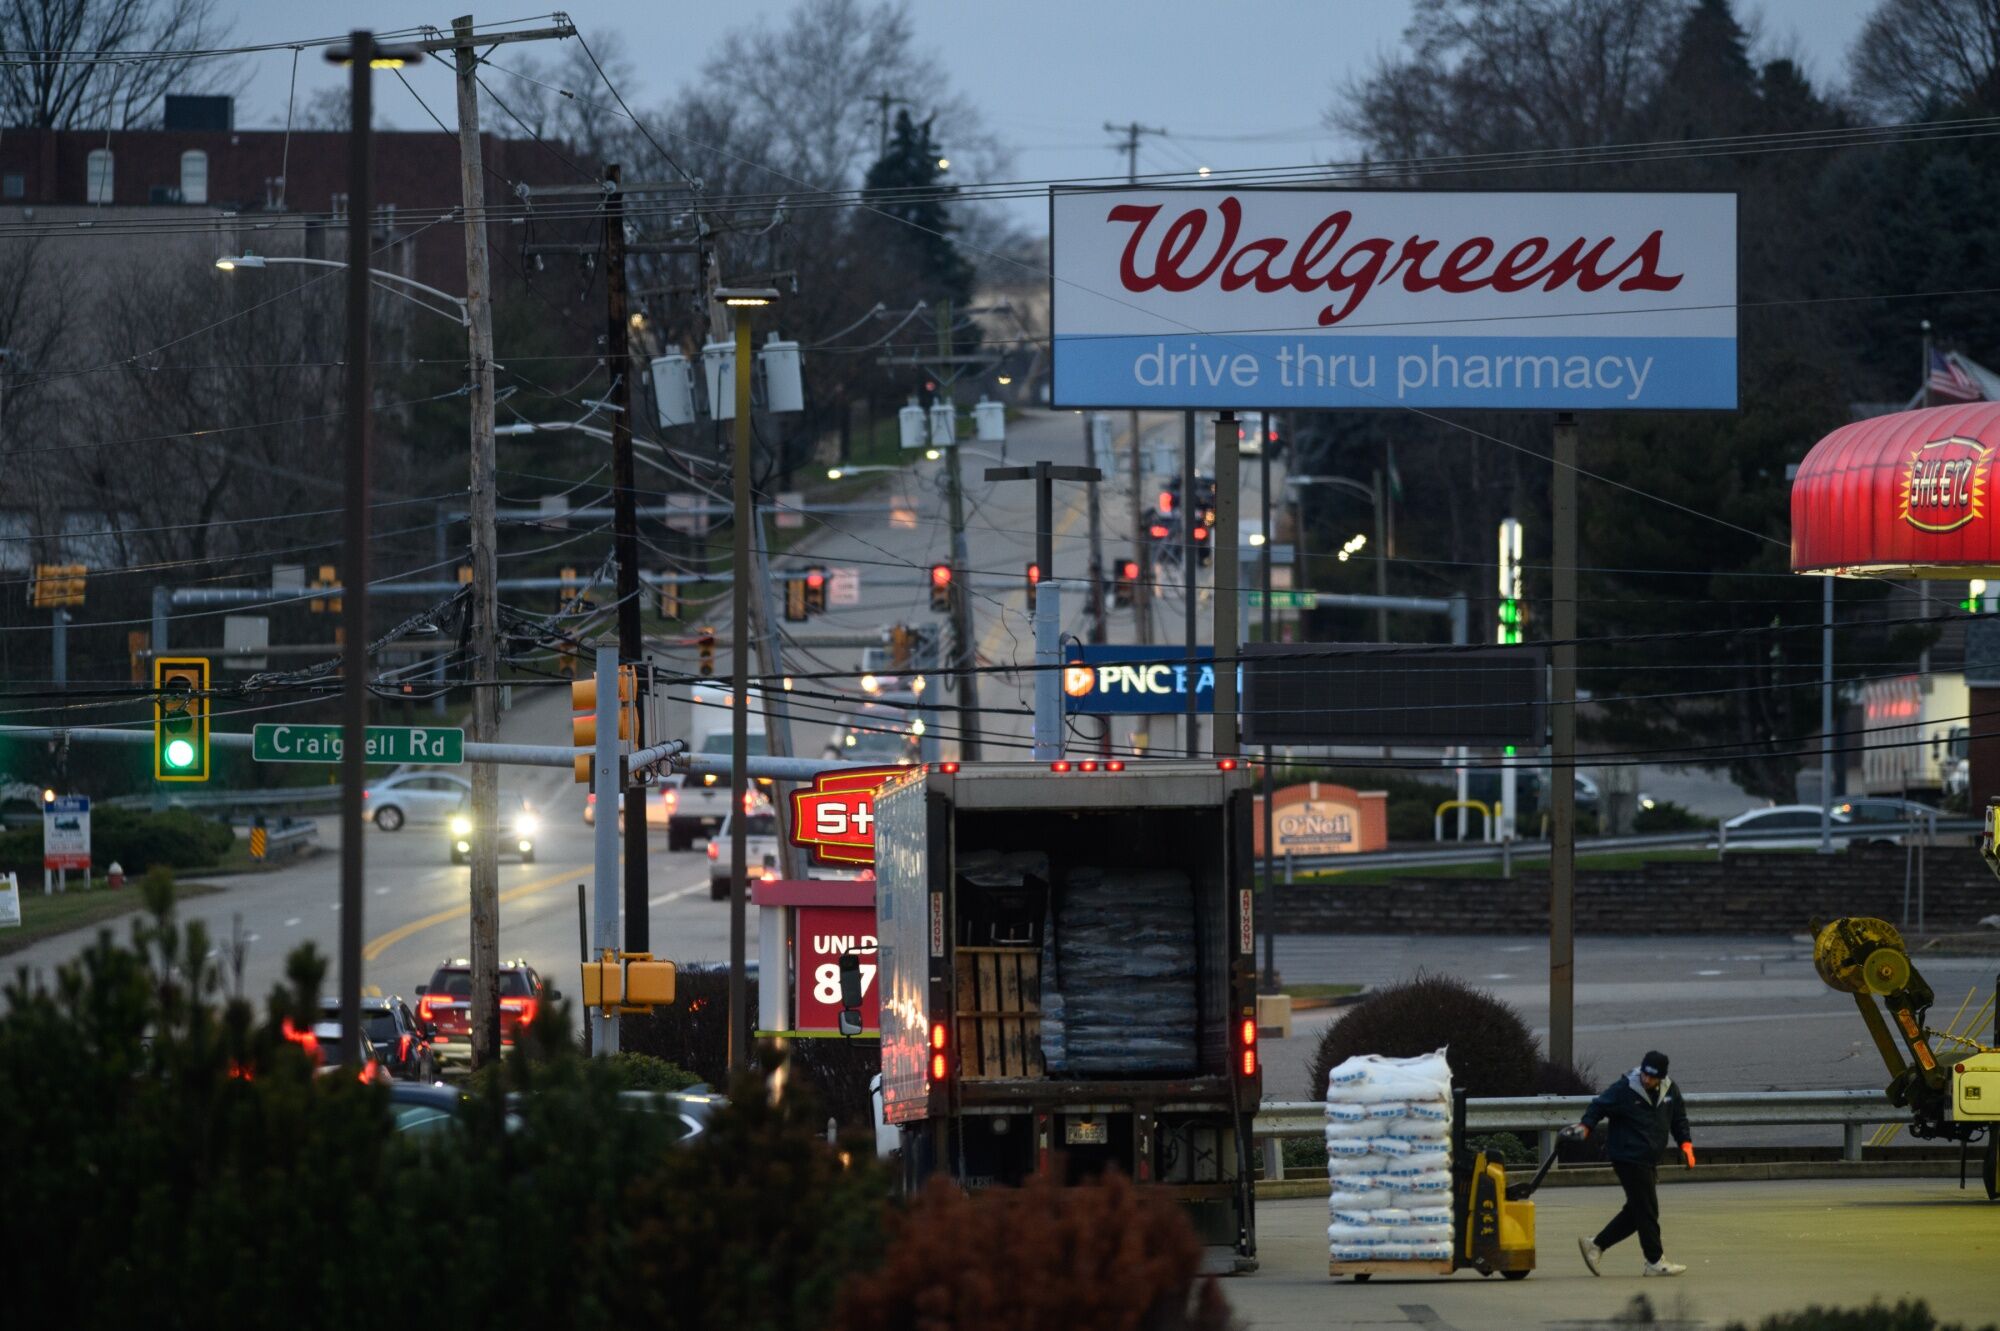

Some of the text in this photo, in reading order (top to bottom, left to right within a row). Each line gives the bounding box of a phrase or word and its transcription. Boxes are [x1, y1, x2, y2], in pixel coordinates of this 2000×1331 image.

[1107, 196, 1684, 327] Walgreens
[1133, 343, 1655, 400] drive thru pharmacy
[1911, 458, 1973, 508] SHEETZ
[273, 727, 445, 760] Craigell Rd
[933, 892, 942, 952] ANTHONY
[1242, 890, 1251, 950] ANTHONY
